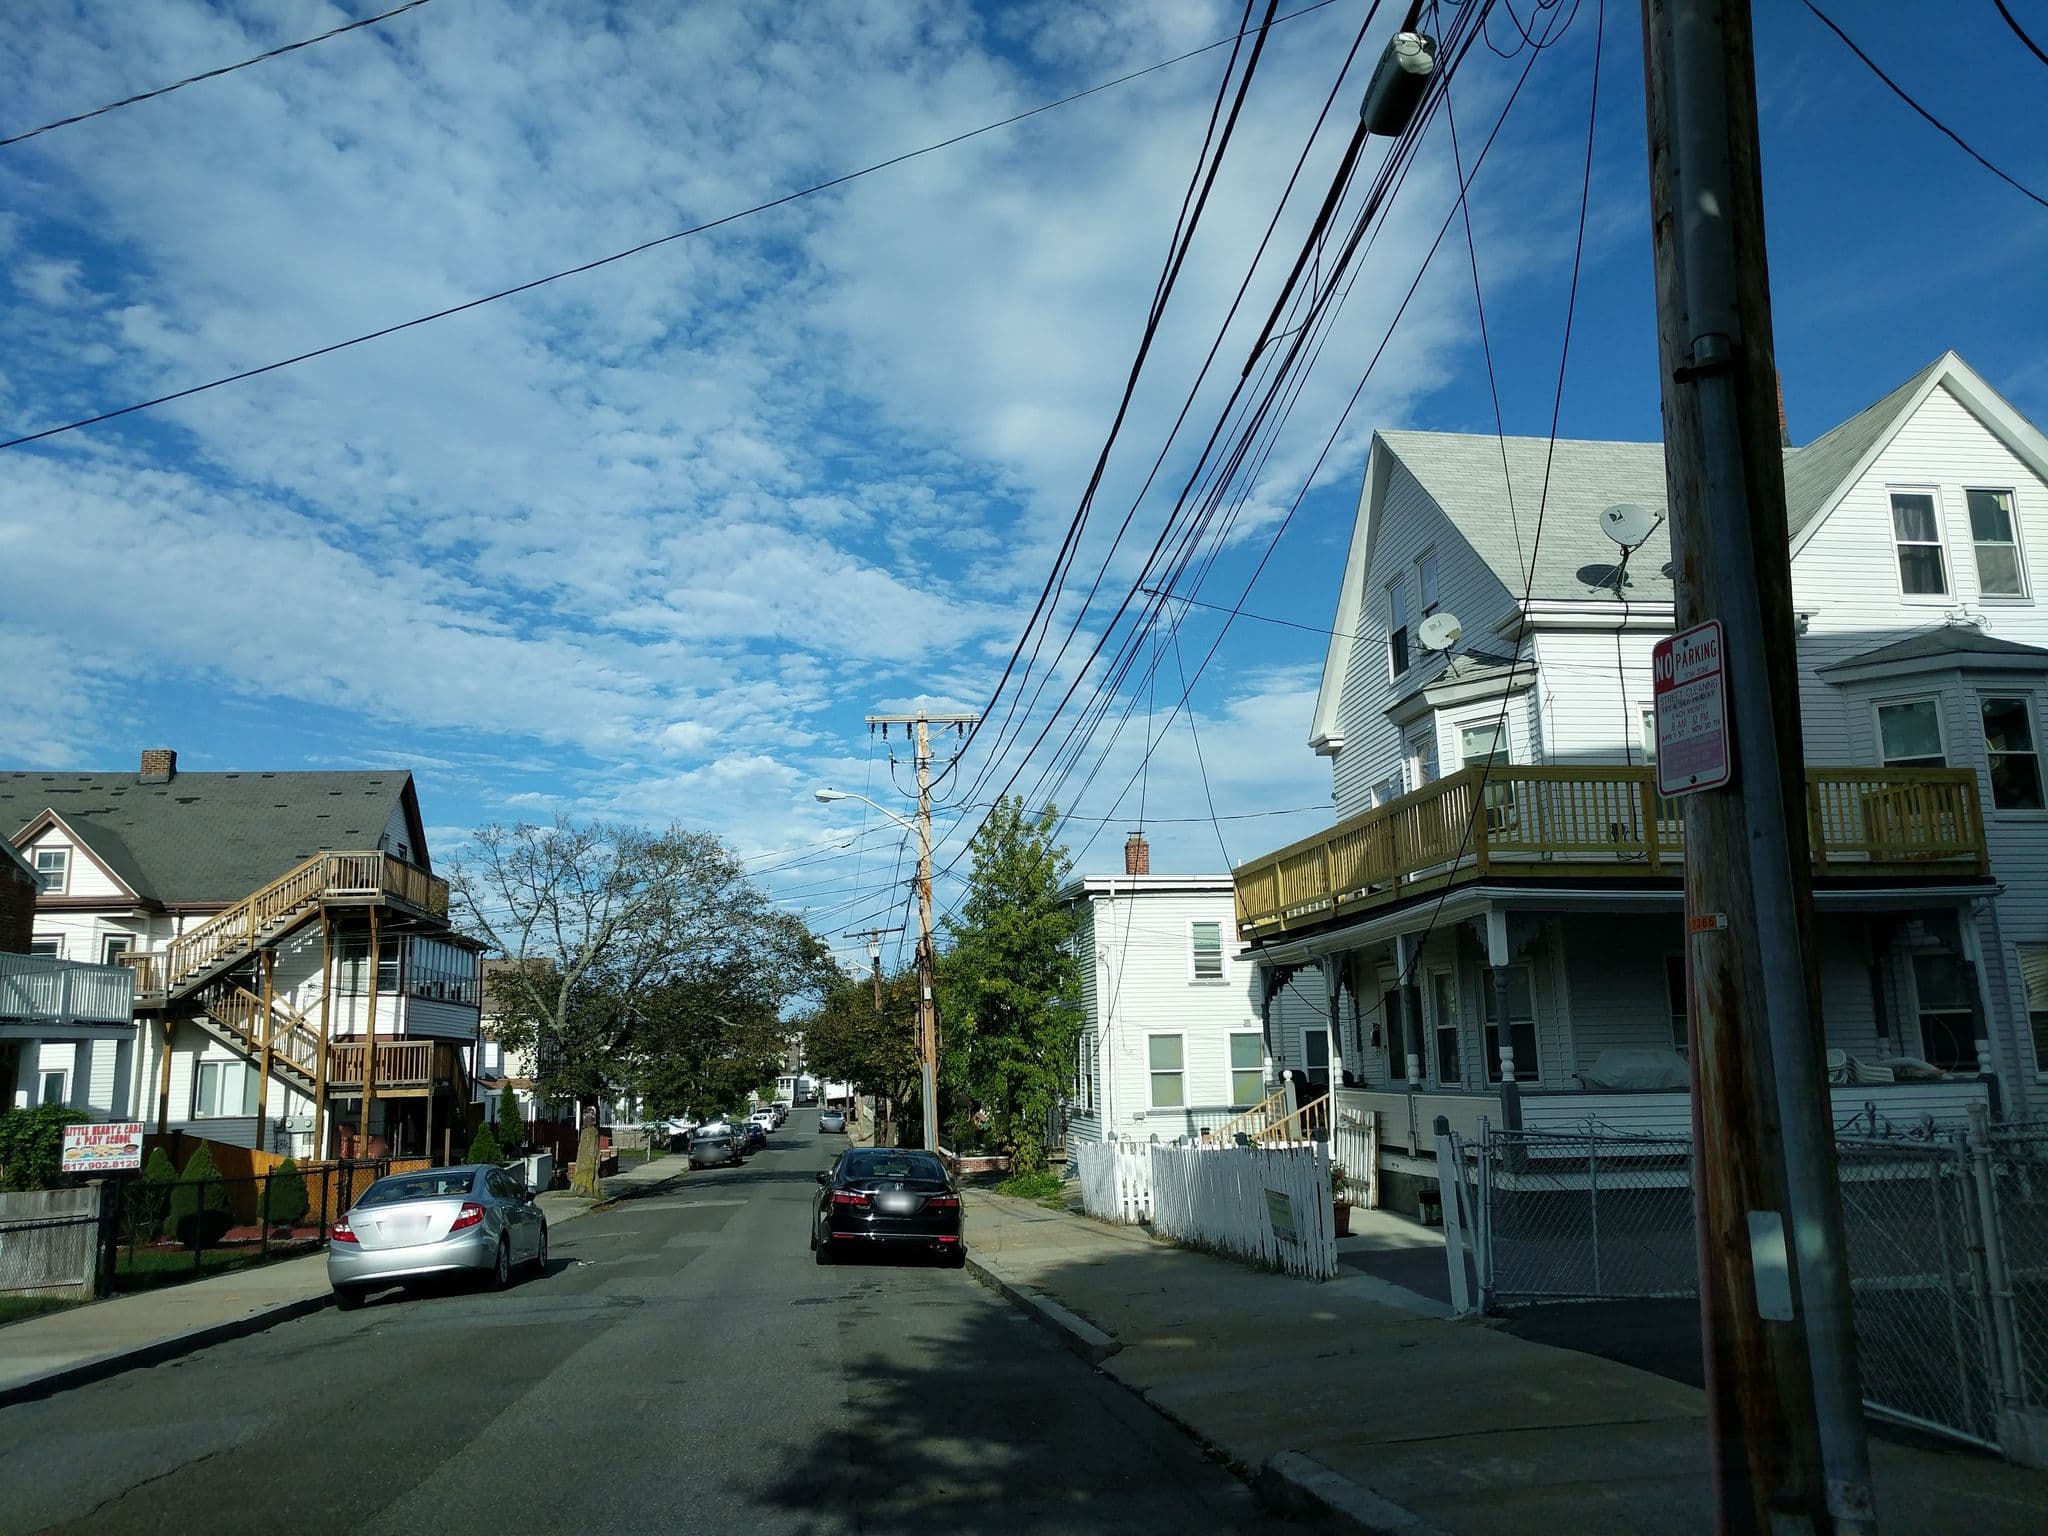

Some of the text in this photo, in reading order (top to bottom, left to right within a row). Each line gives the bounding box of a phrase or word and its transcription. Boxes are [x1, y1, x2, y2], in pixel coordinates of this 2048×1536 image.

[1656, 640, 1716, 683] NO PARKING
[1660, 679, 1718, 705] STREET CLEANING
[1672, 704, 1707, 720] EACH MONTH
[1676, 719, 1687, 730] AM
[1699, 712, 1709, 722] PM
[1662, 733, 1673, 744] APR
[1692, 725, 1702, 736] NOV
[64, 1126, 90, 1136] LITTLE
[92, 1125, 122, 1135] HEART'S
[75, 1134, 131, 1146] & PLAY SCHOOL
[63, 1160, 139, 1171] 617.902.8120
